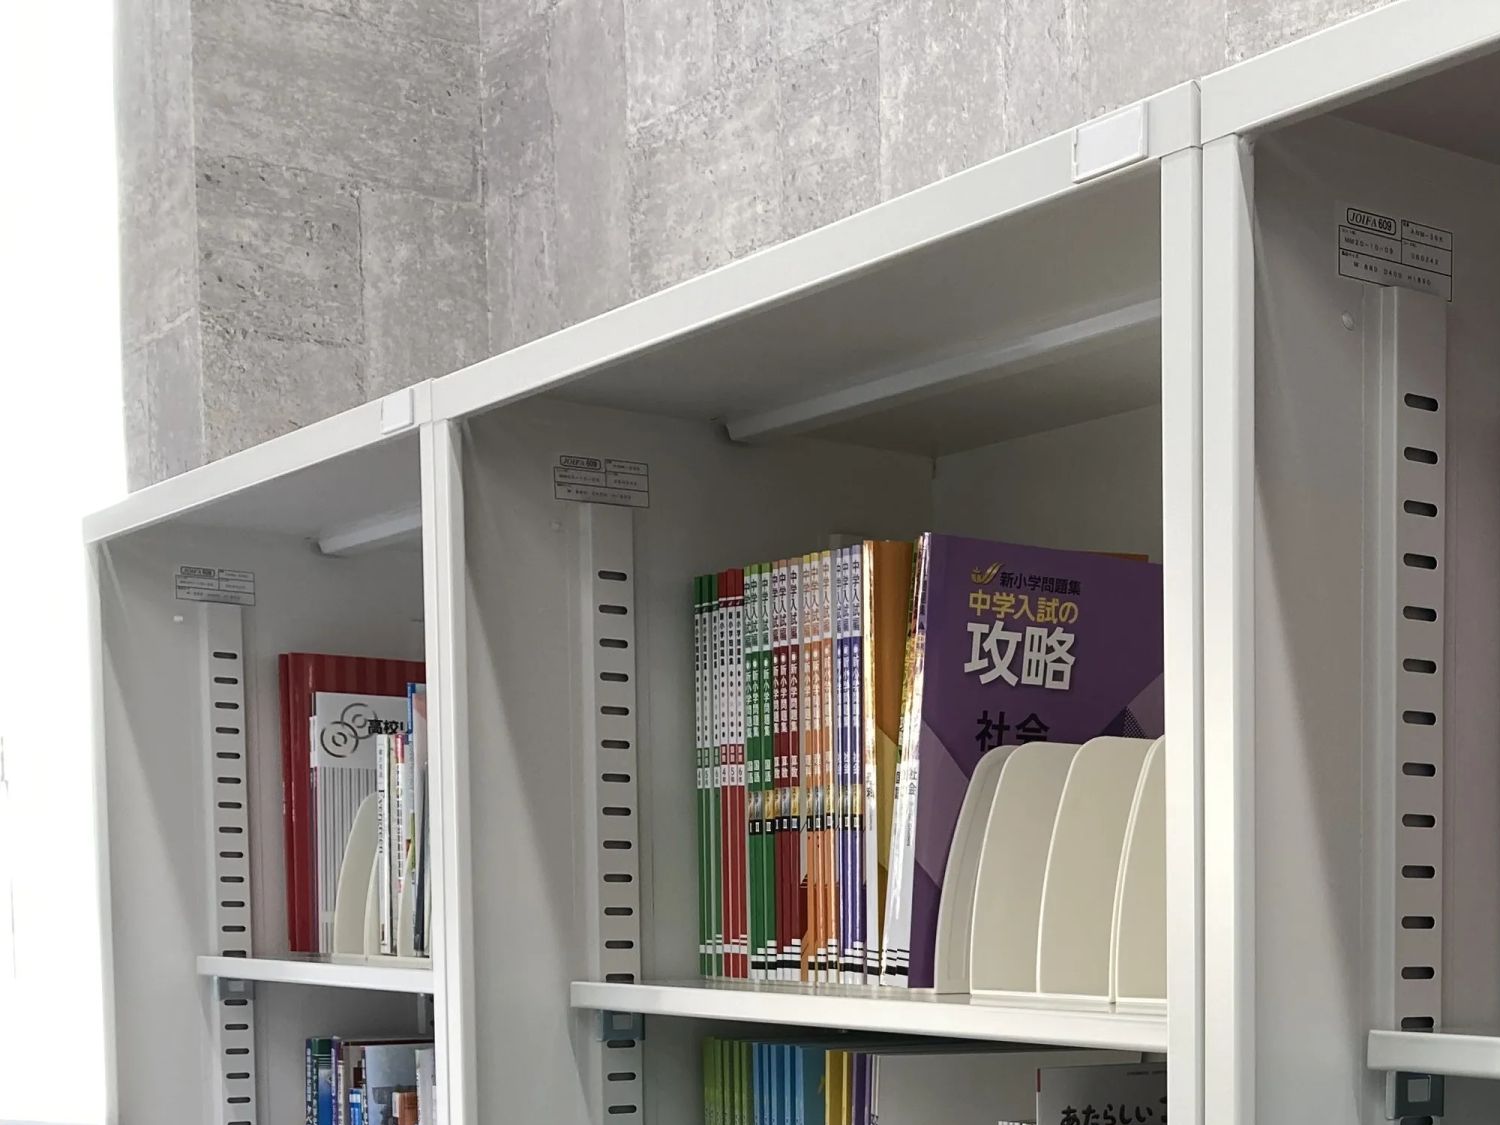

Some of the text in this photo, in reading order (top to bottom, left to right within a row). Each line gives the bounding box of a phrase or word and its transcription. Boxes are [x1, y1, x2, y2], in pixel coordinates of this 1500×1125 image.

[1000, 573, 1081, 595] 新小学問題集
[968, 590, 1078, 624] 中学入試の
[964, 621, 1076, 690] 攻略
